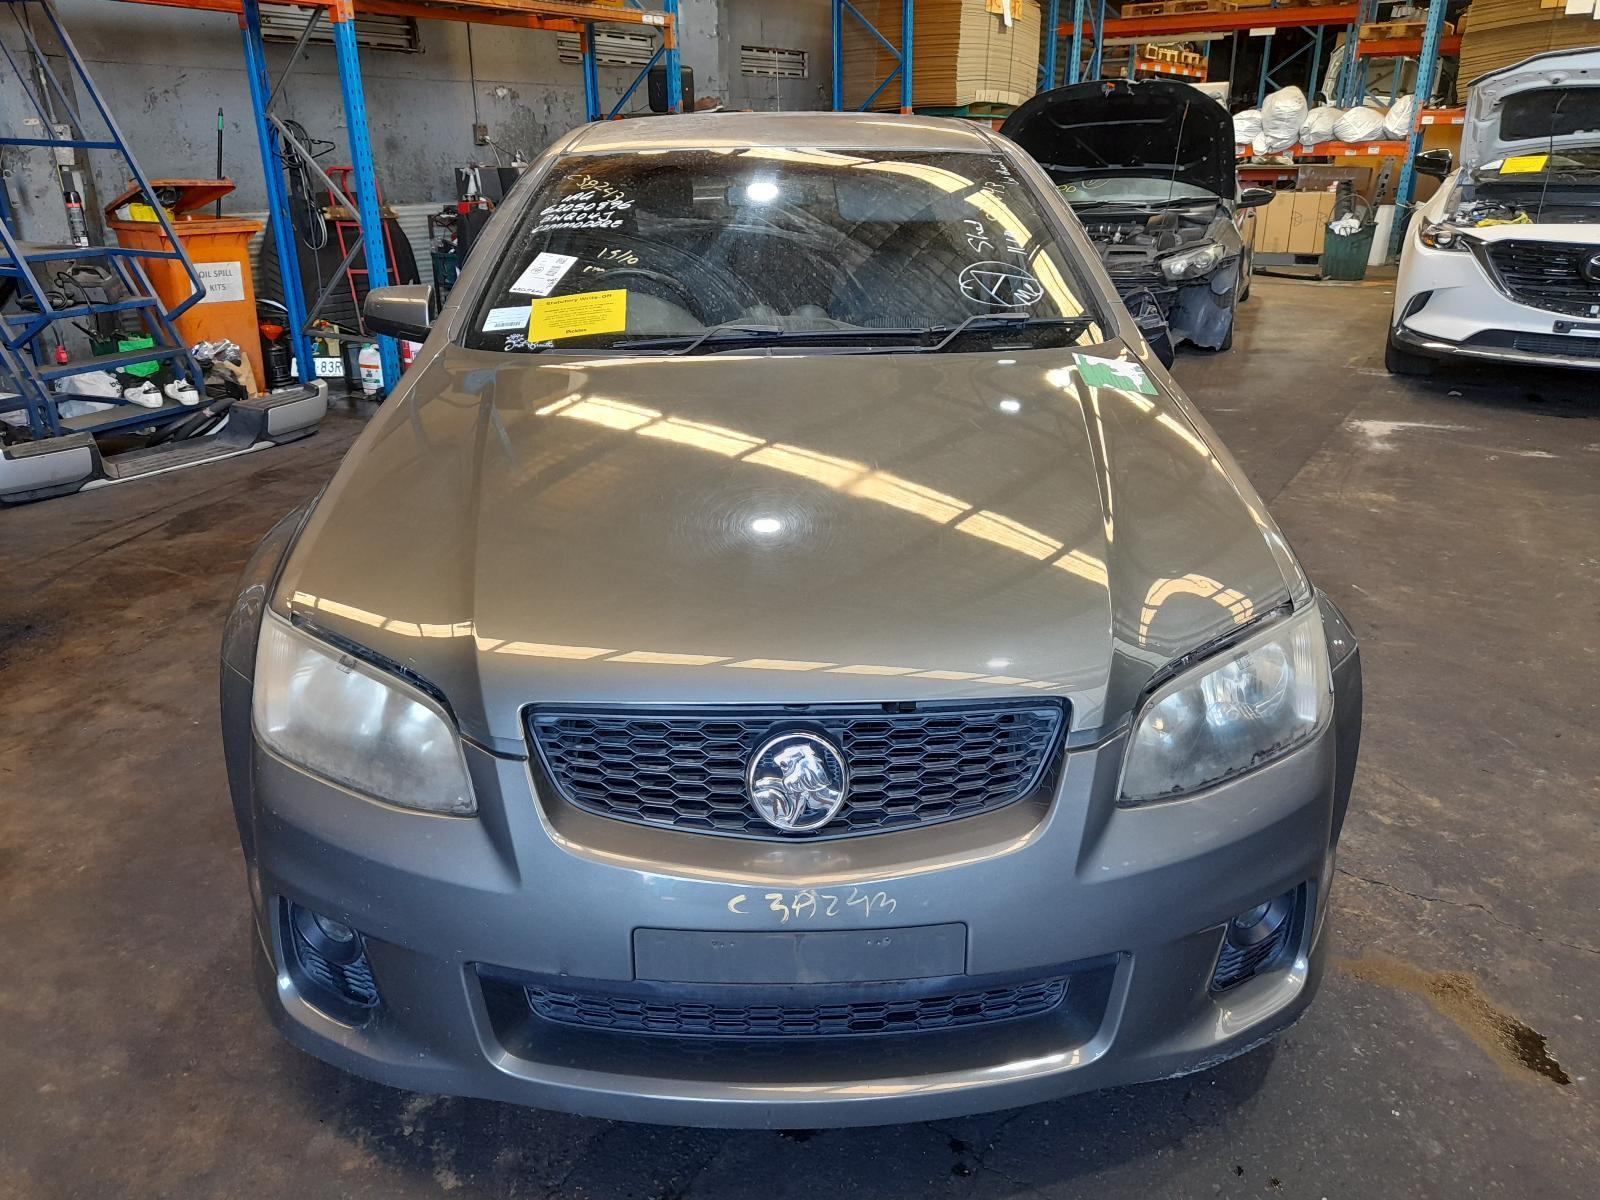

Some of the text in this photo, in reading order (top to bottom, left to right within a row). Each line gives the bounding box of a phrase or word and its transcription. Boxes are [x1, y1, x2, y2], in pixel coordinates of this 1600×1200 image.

[531, 219, 624, 234] COMMODORE
[198, 269, 233, 279] OIL SPILL
[209, 283, 227, 292] KITS
